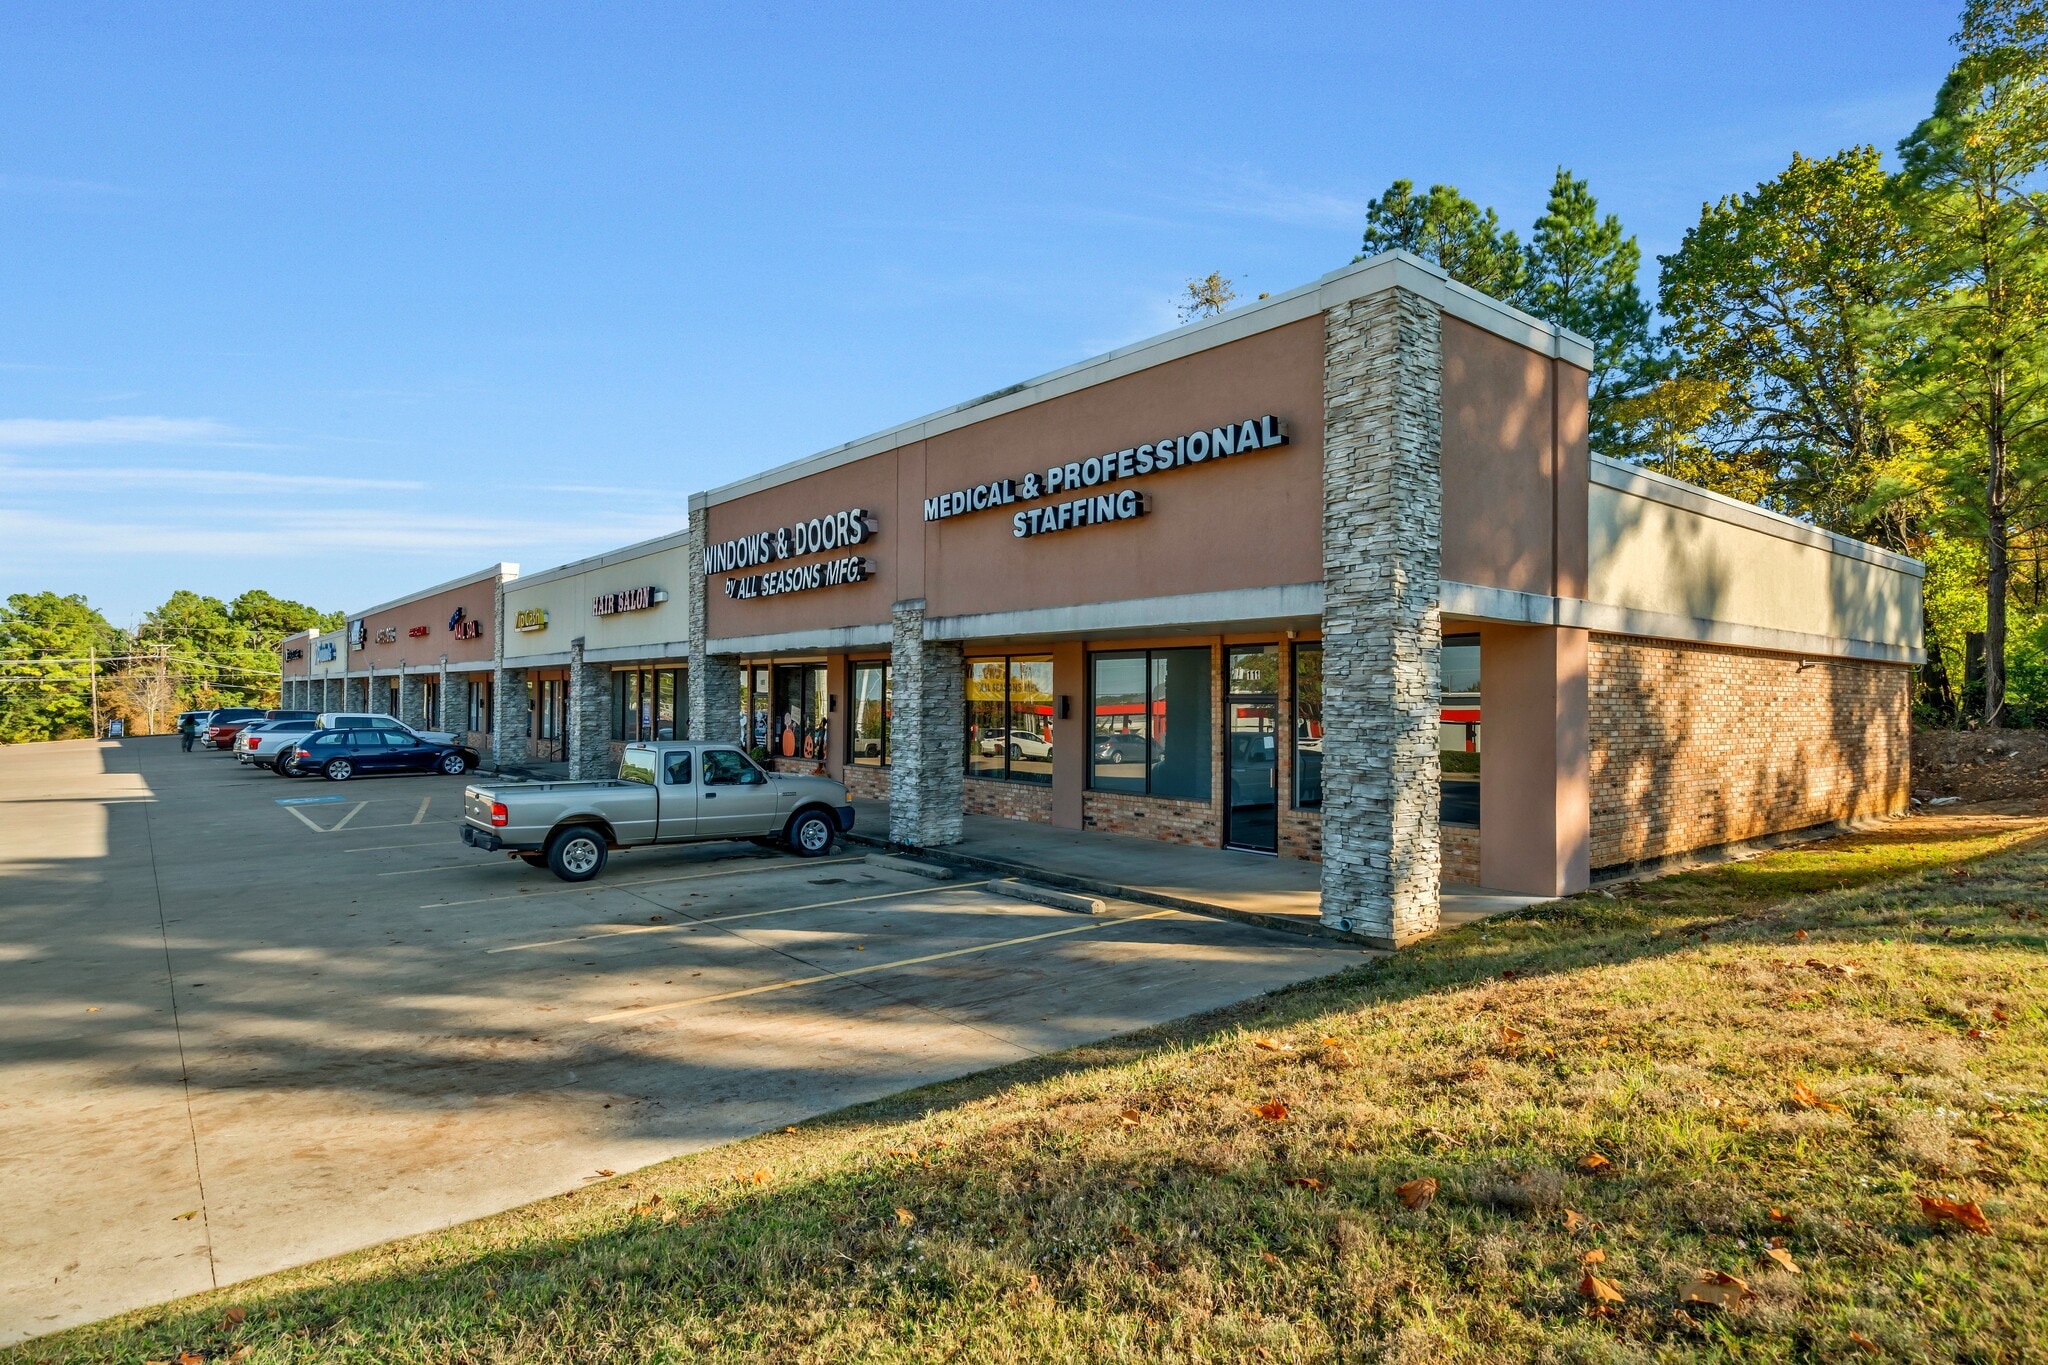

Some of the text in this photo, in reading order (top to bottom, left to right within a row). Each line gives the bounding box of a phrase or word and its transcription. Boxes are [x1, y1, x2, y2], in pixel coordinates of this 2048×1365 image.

[924, 414, 1283, 522] MEDICAL & PROFESSIONAL
[1013, 489, 1138, 538] STAFFING
[703, 508, 863, 575] WINDOWS & DOORS
[592, 586, 651, 616] HAIR SALON
[725, 556, 862, 600] by ALL SEASONS MFG.
